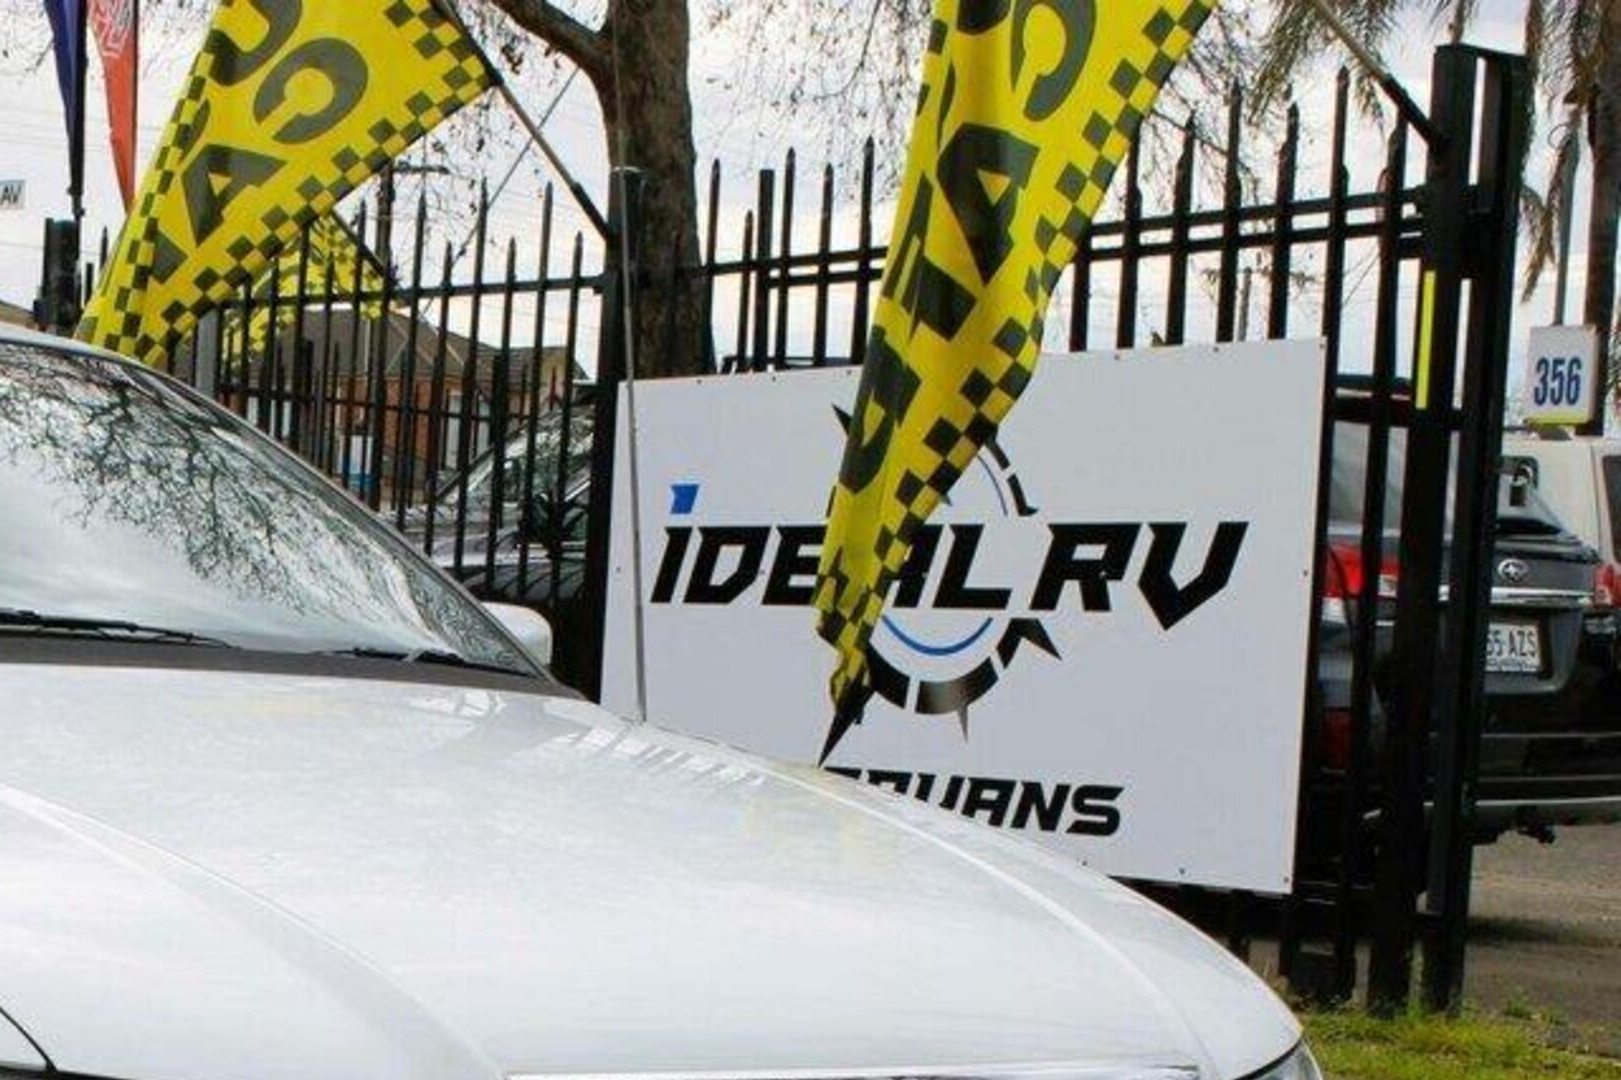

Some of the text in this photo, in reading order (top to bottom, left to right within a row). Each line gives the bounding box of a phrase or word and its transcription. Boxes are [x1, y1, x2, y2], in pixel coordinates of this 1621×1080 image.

[1, 183, 23, 206] AV
[1534, 356, 1582, 406] 356
[1029, 521, 1249, 631] RV
